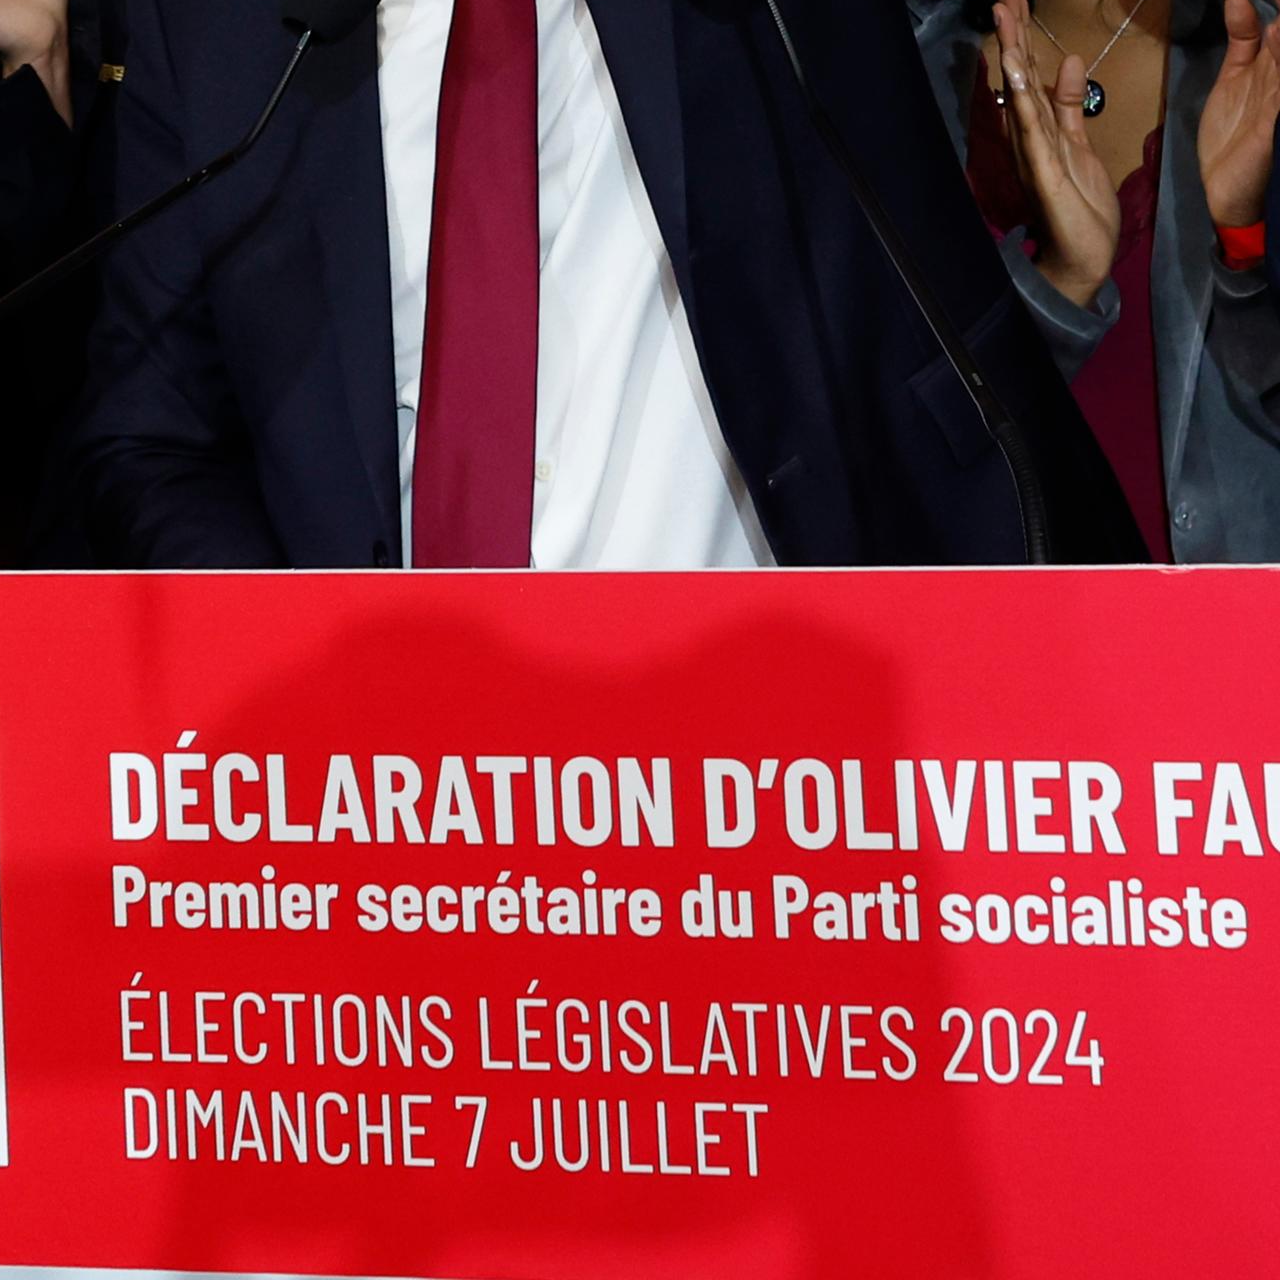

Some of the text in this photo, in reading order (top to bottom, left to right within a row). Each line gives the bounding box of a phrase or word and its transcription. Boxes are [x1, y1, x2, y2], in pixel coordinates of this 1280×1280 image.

[109, 730, 674, 848] DÉCLARATION
[112, 864, 1248, 950] Premier secrétaire du Parti socialiste
[120, 970, 1106, 1087] ÉLECTIONS LÉGISLATIVES 2024
[124, 1087, 769, 1178] DIMANCHE 7 JUILLET
